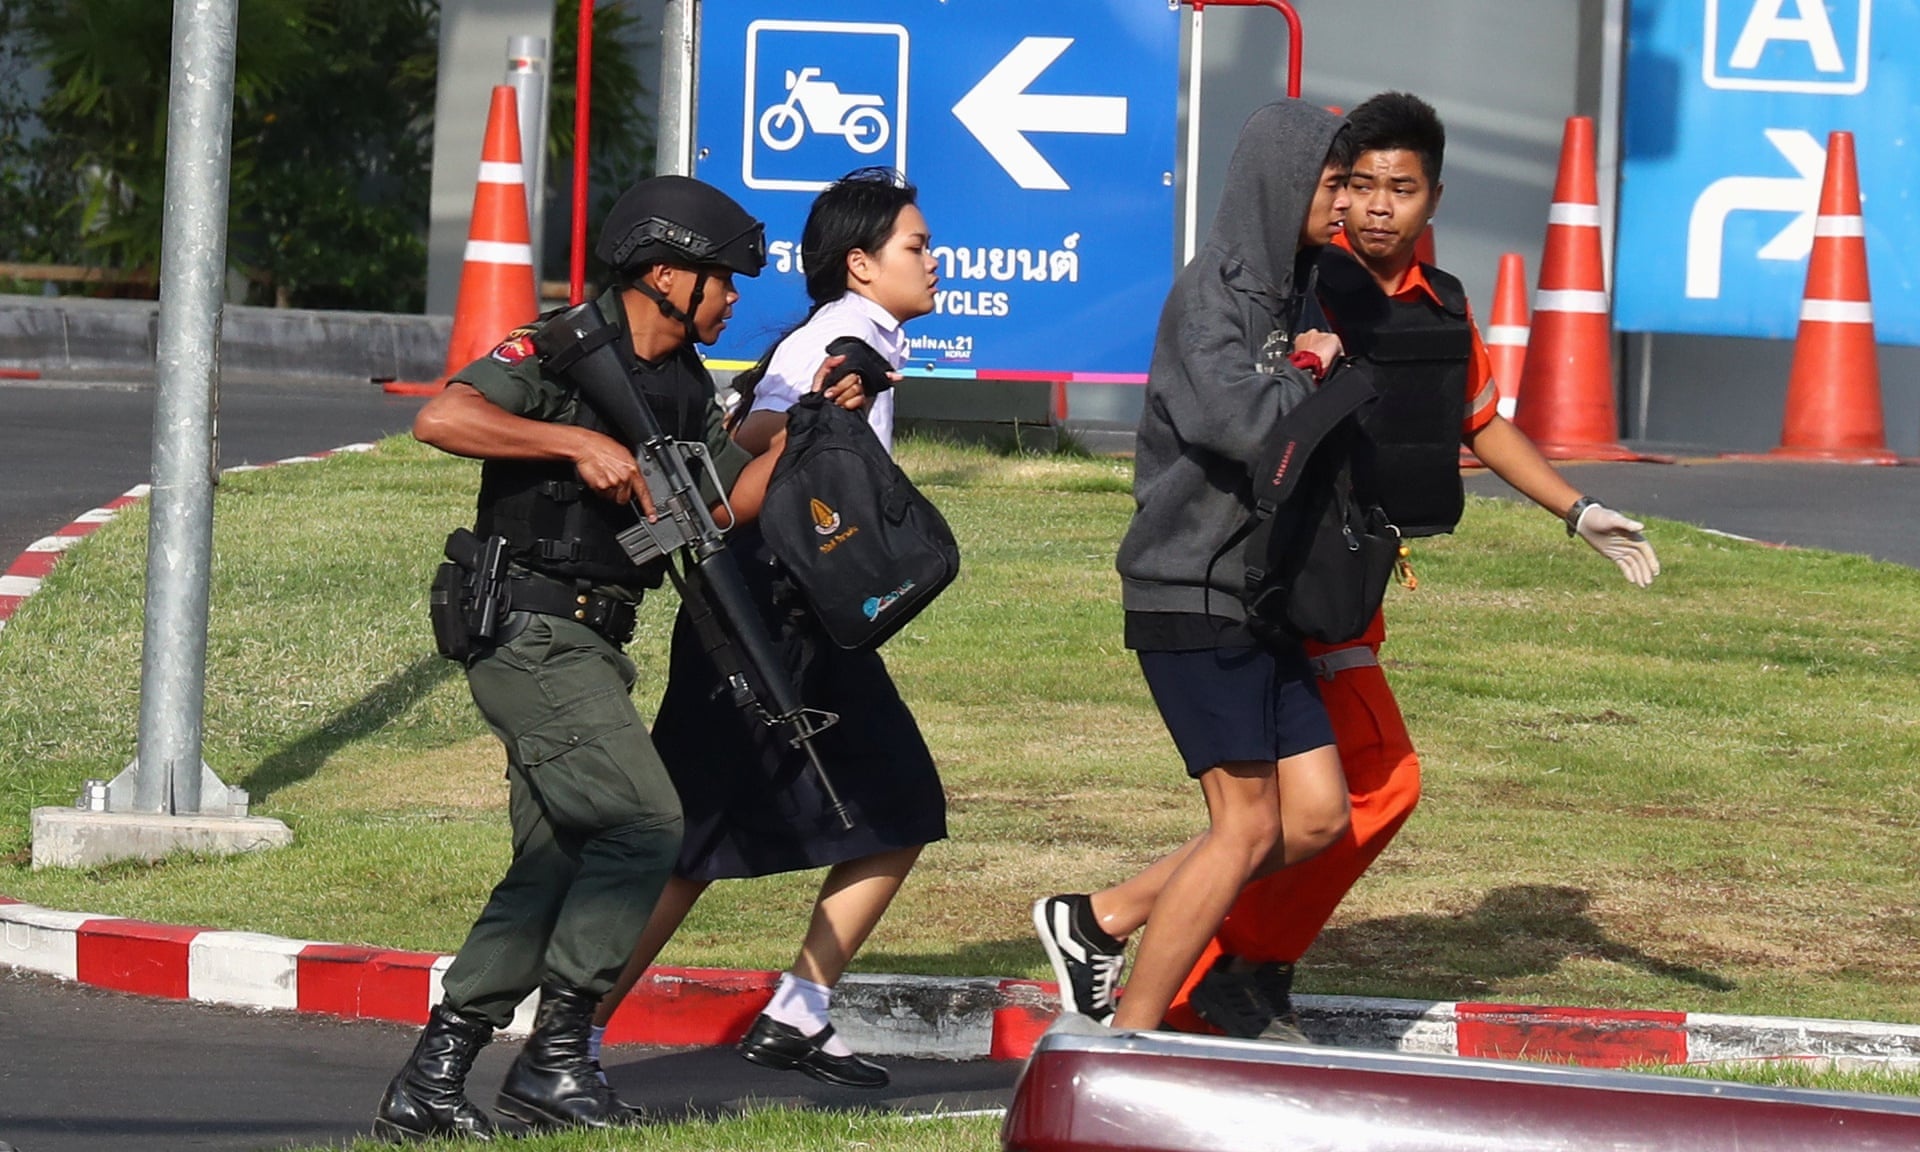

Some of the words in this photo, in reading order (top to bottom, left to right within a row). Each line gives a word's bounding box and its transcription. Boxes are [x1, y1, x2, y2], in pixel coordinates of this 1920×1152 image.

[1729, 0, 1845, 73] A
[934, 290, 1009, 316] YCLES
[909, 335, 973, 351] MINAL21
